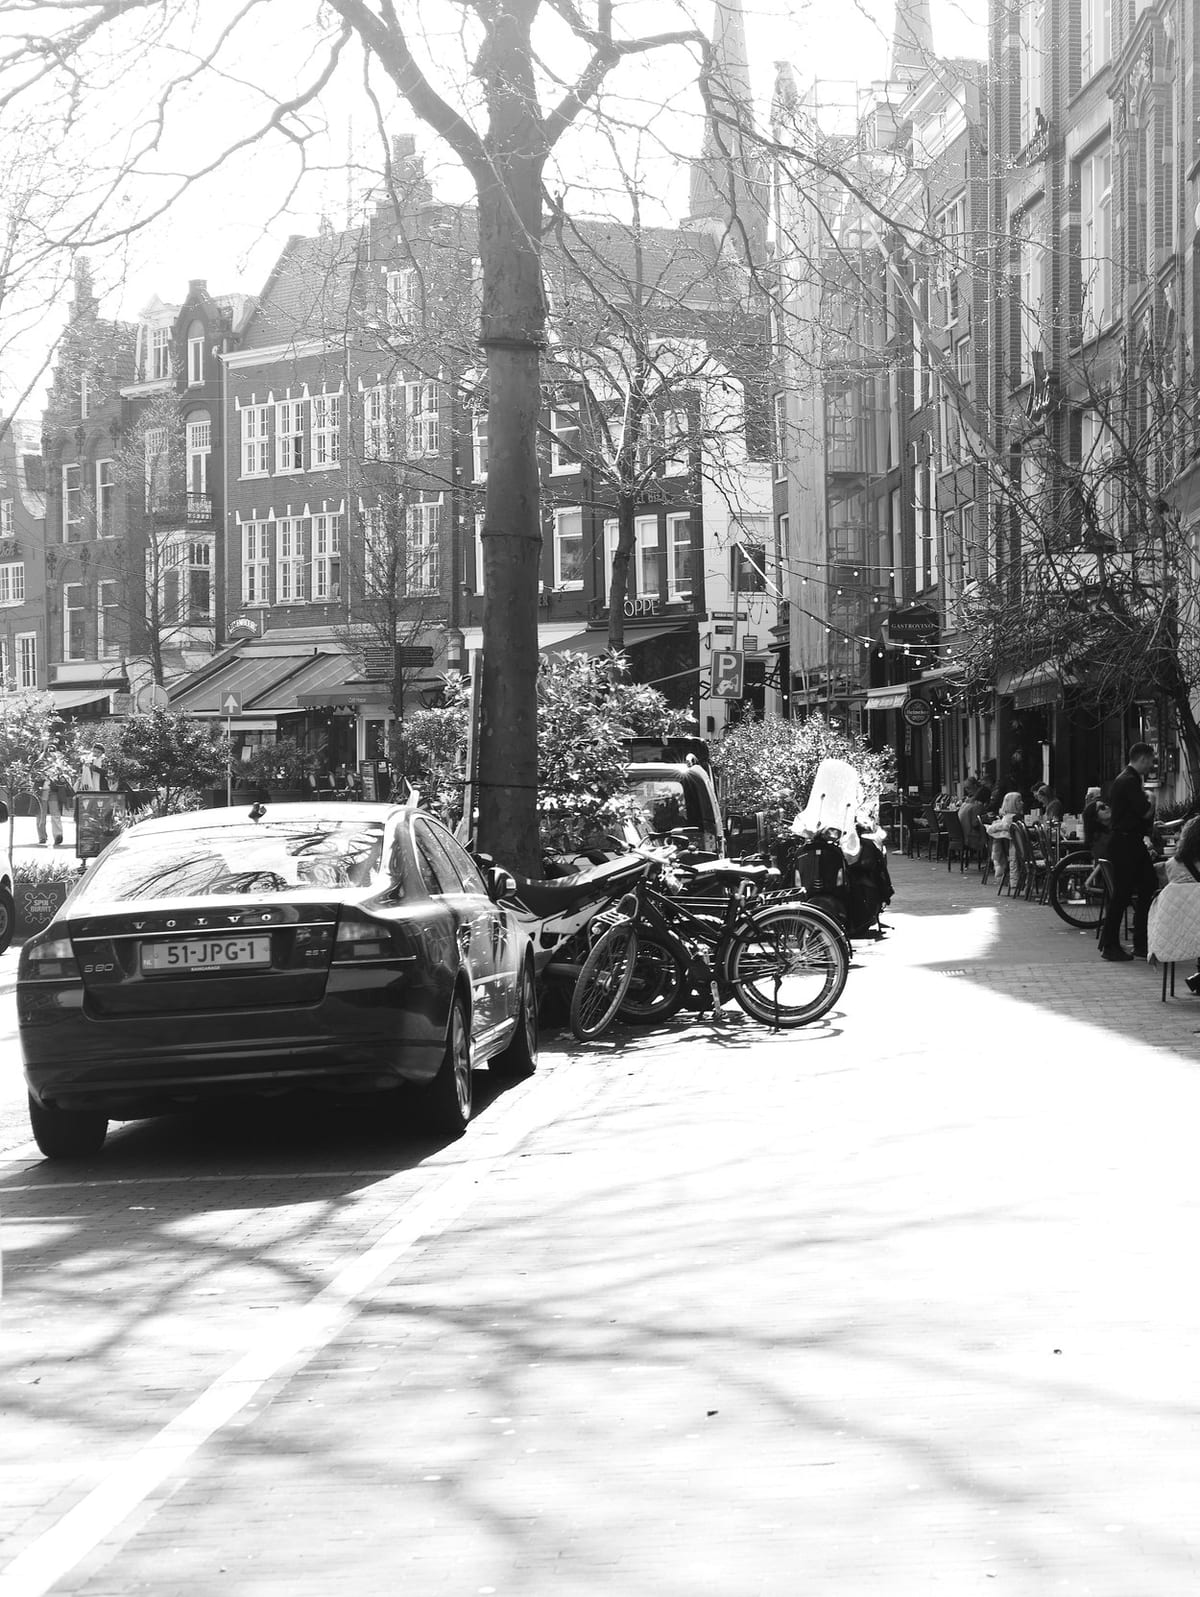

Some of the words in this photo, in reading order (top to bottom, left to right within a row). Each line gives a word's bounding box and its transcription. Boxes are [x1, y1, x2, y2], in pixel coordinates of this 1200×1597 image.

[623, 599, 660, 617] OPPE
[718, 654, 737, 678] P
[133, 912, 273, 930] VOLVO
[167, 941, 255, 965] 51-JPG-1
